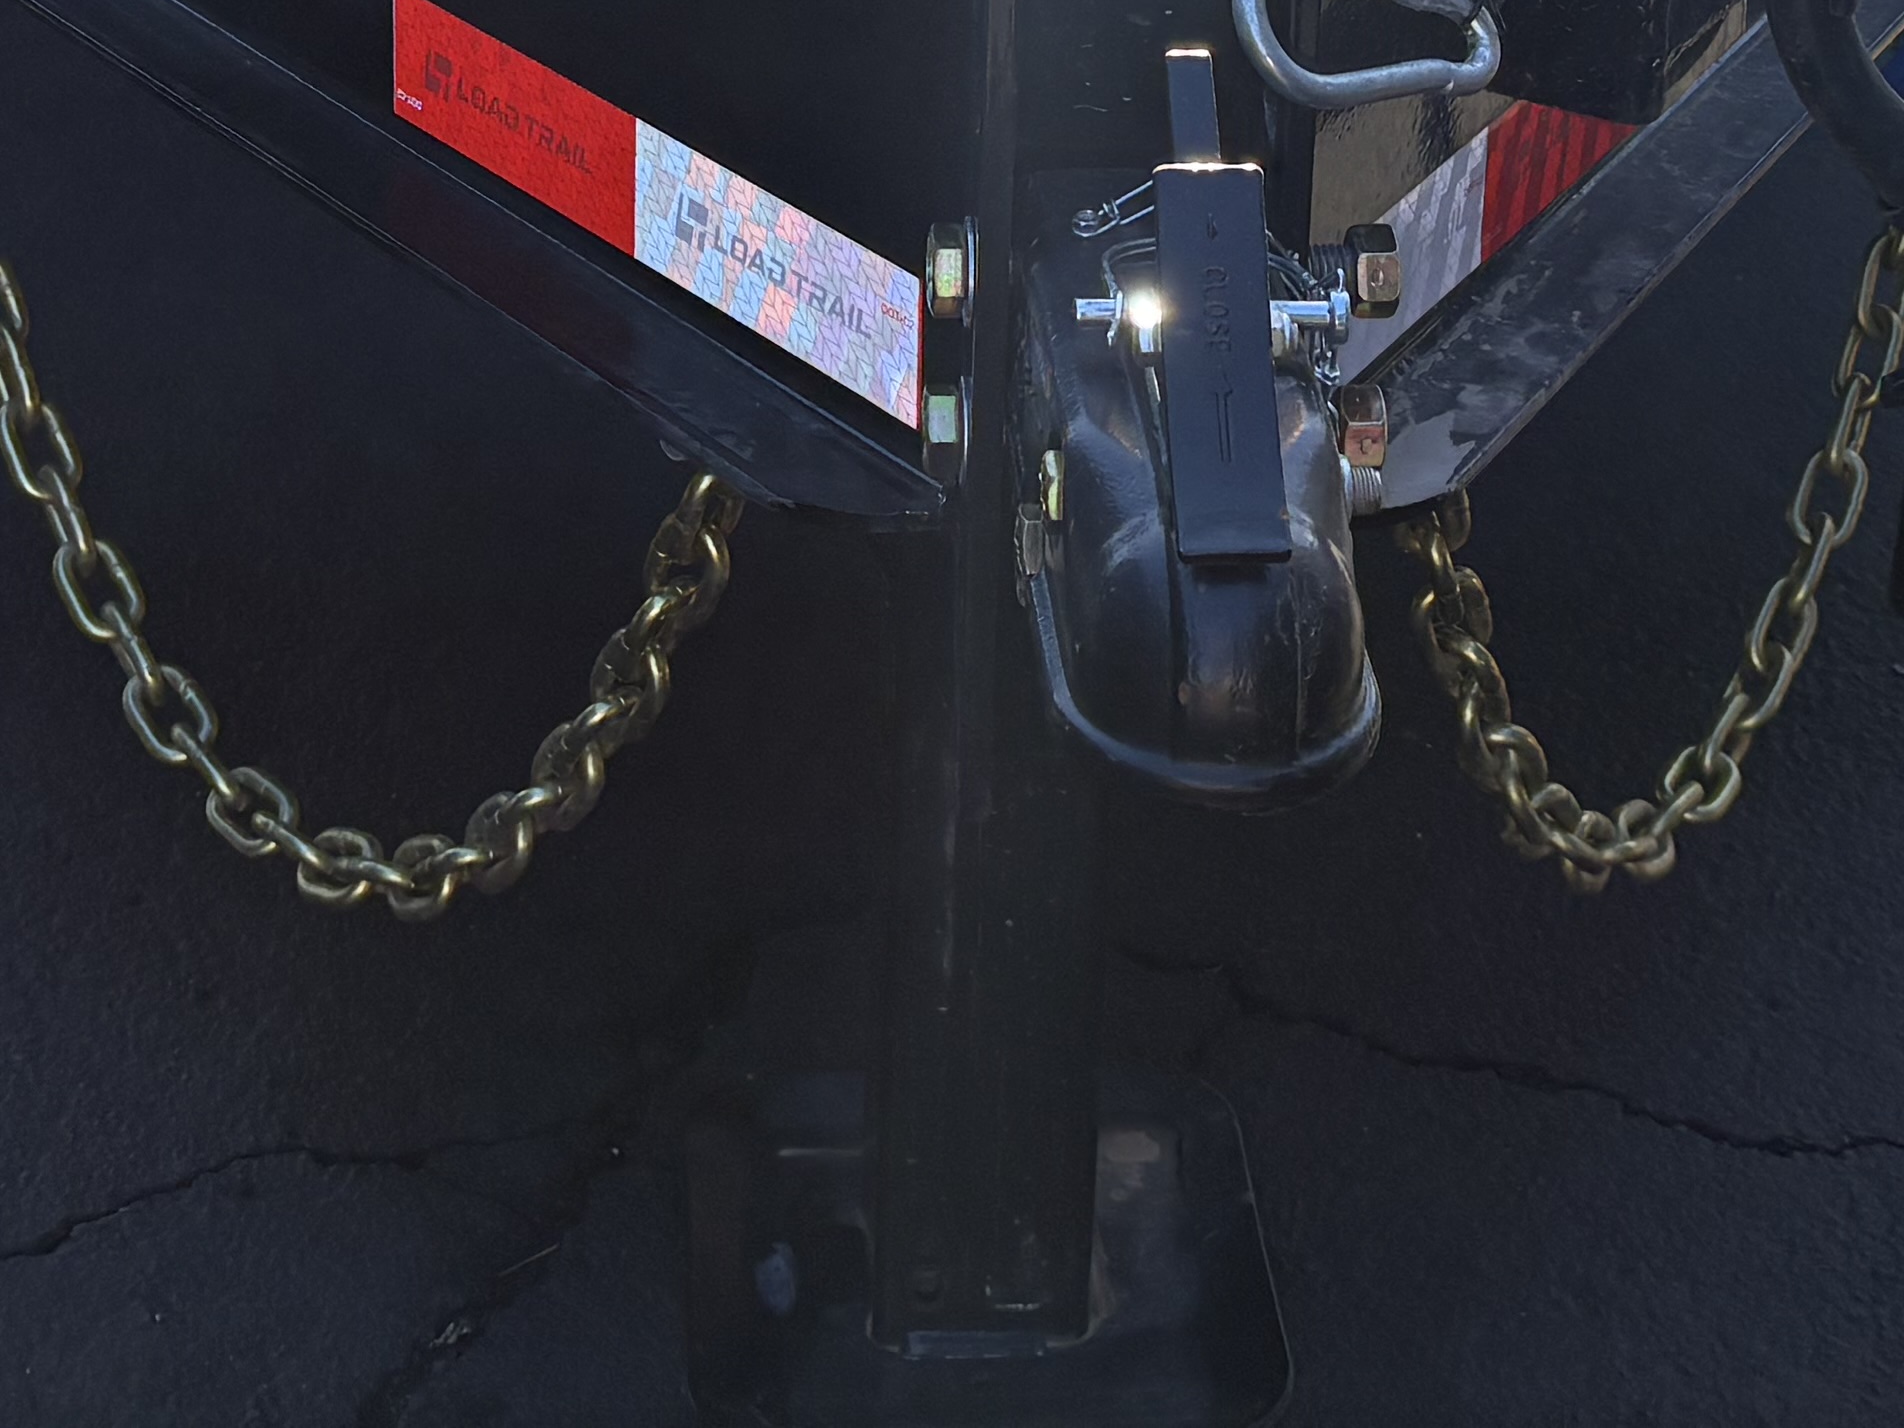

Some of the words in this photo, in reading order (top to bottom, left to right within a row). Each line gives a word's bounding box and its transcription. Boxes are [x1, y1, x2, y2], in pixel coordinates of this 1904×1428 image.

[457, 76, 520, 131] LOAD
[524, 113, 593, 175] TRAIL
[711, 224, 787, 287] LOAD
[790, 268, 872, 340] TRAIL
